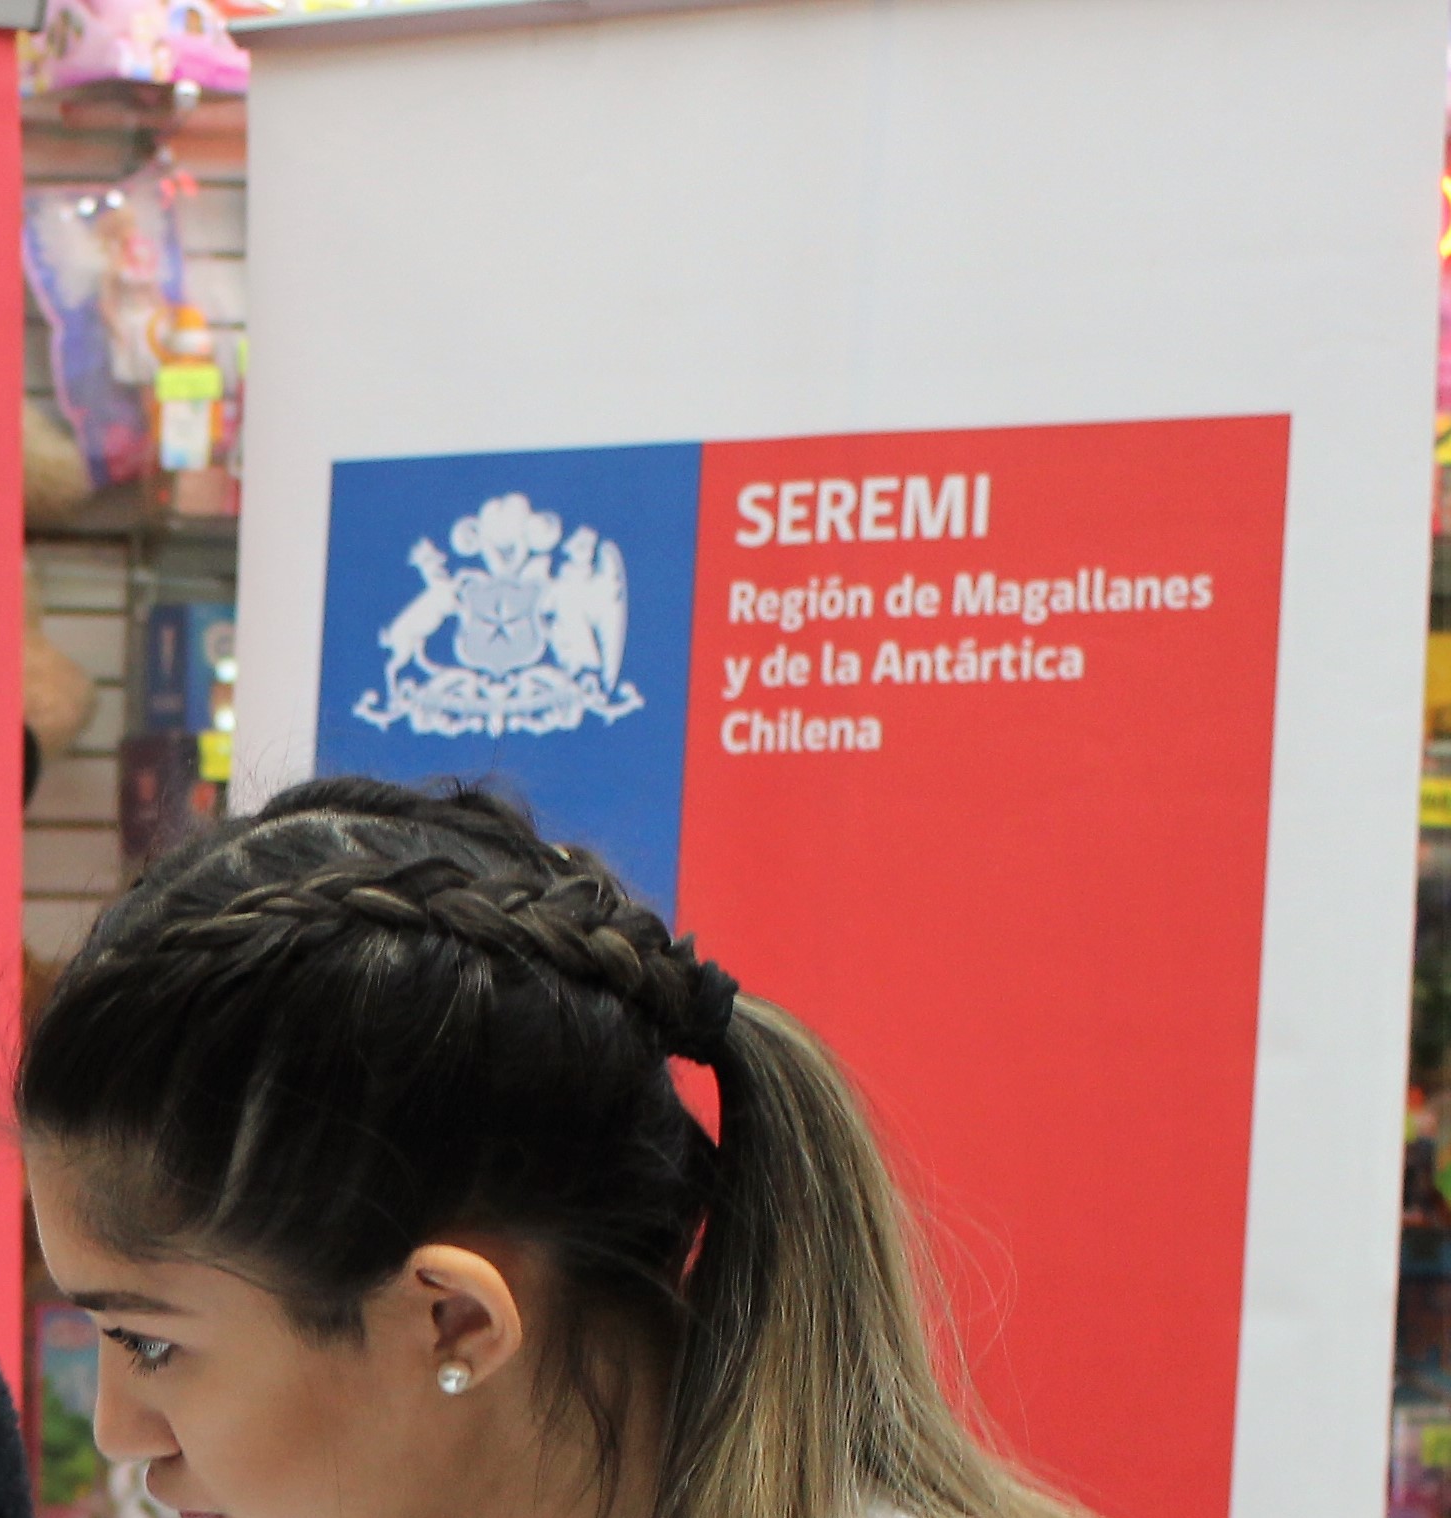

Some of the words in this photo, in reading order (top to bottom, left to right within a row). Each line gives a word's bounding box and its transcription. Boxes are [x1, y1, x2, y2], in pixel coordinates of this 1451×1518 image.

[735, 472, 991, 548] SEREMI
[728, 575, 875, 633] Región
[884, 573, 942, 618] de
[951, 567, 1213, 626] Magallanes
[722, 656, 752, 700] y
[759, 644, 812, 688] de
[820, 642, 862, 686] la
[871, 637, 1085, 684] Antártica
[720, 708, 883, 755] Chilena
